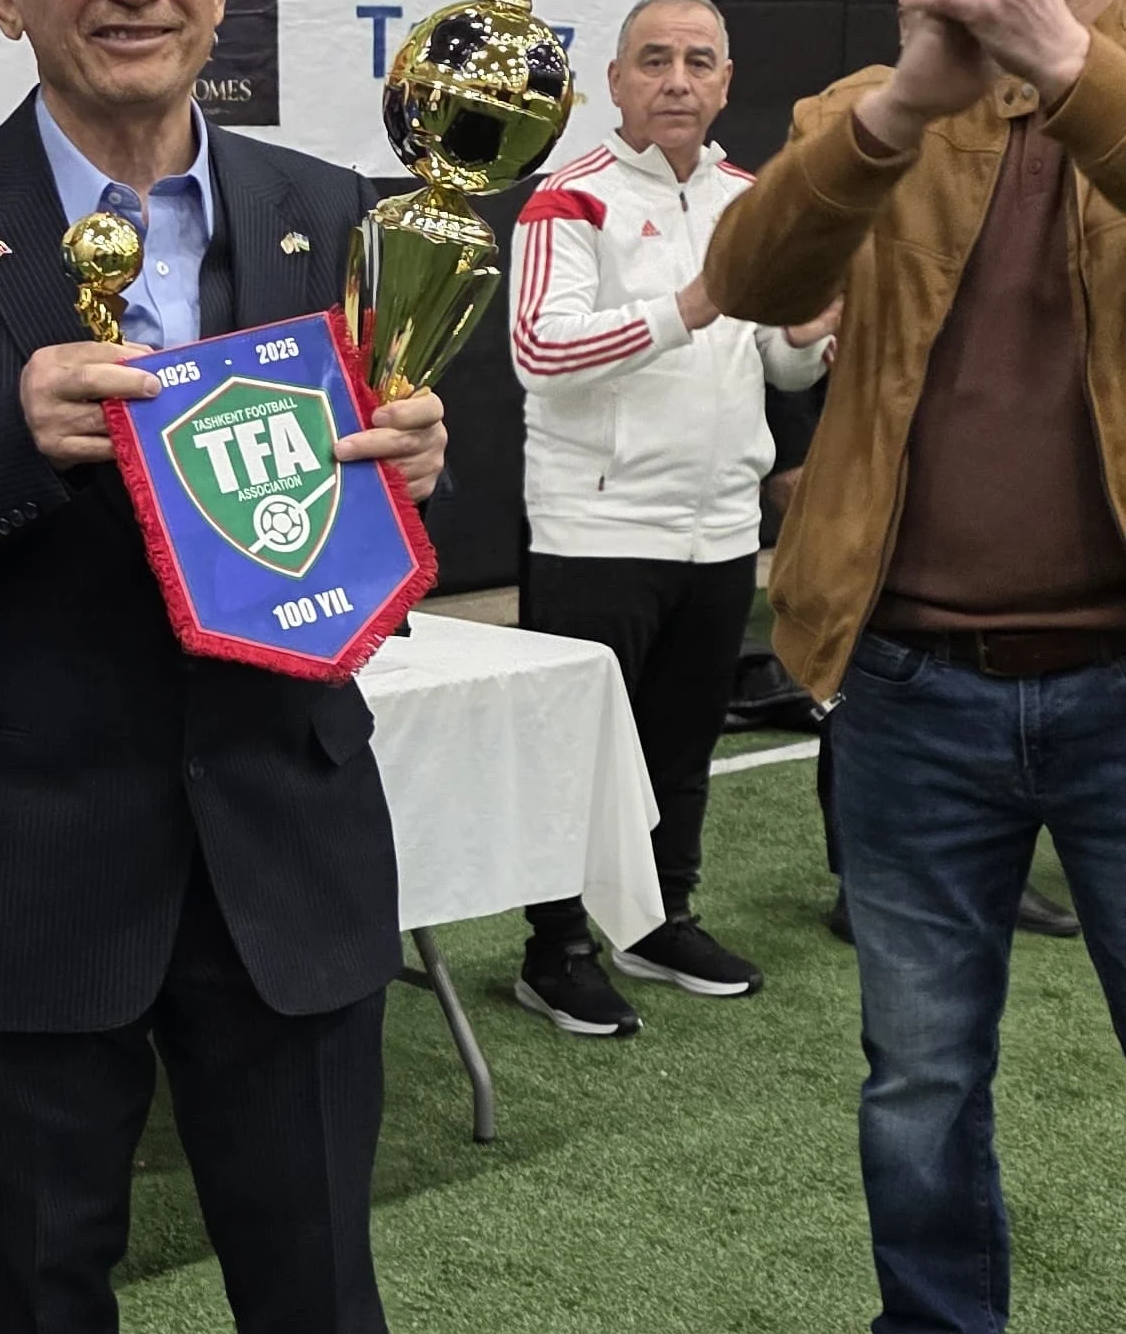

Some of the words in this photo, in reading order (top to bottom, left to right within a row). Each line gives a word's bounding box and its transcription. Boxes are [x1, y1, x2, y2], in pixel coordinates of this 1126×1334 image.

[193, 78, 252, 102] OMES
[157, 361, 201, 389] 1925
[255, 337, 300, 365] 2025
[192, 410, 244, 432] TASHKENT
[244, 397, 298, 420] FOOTBALL
[193, 411, 322, 494] TFA
[237, 474, 303, 502] ASSOCIATION
[273, 597, 317, 631] 100
[315, 587, 354, 618] YIL
